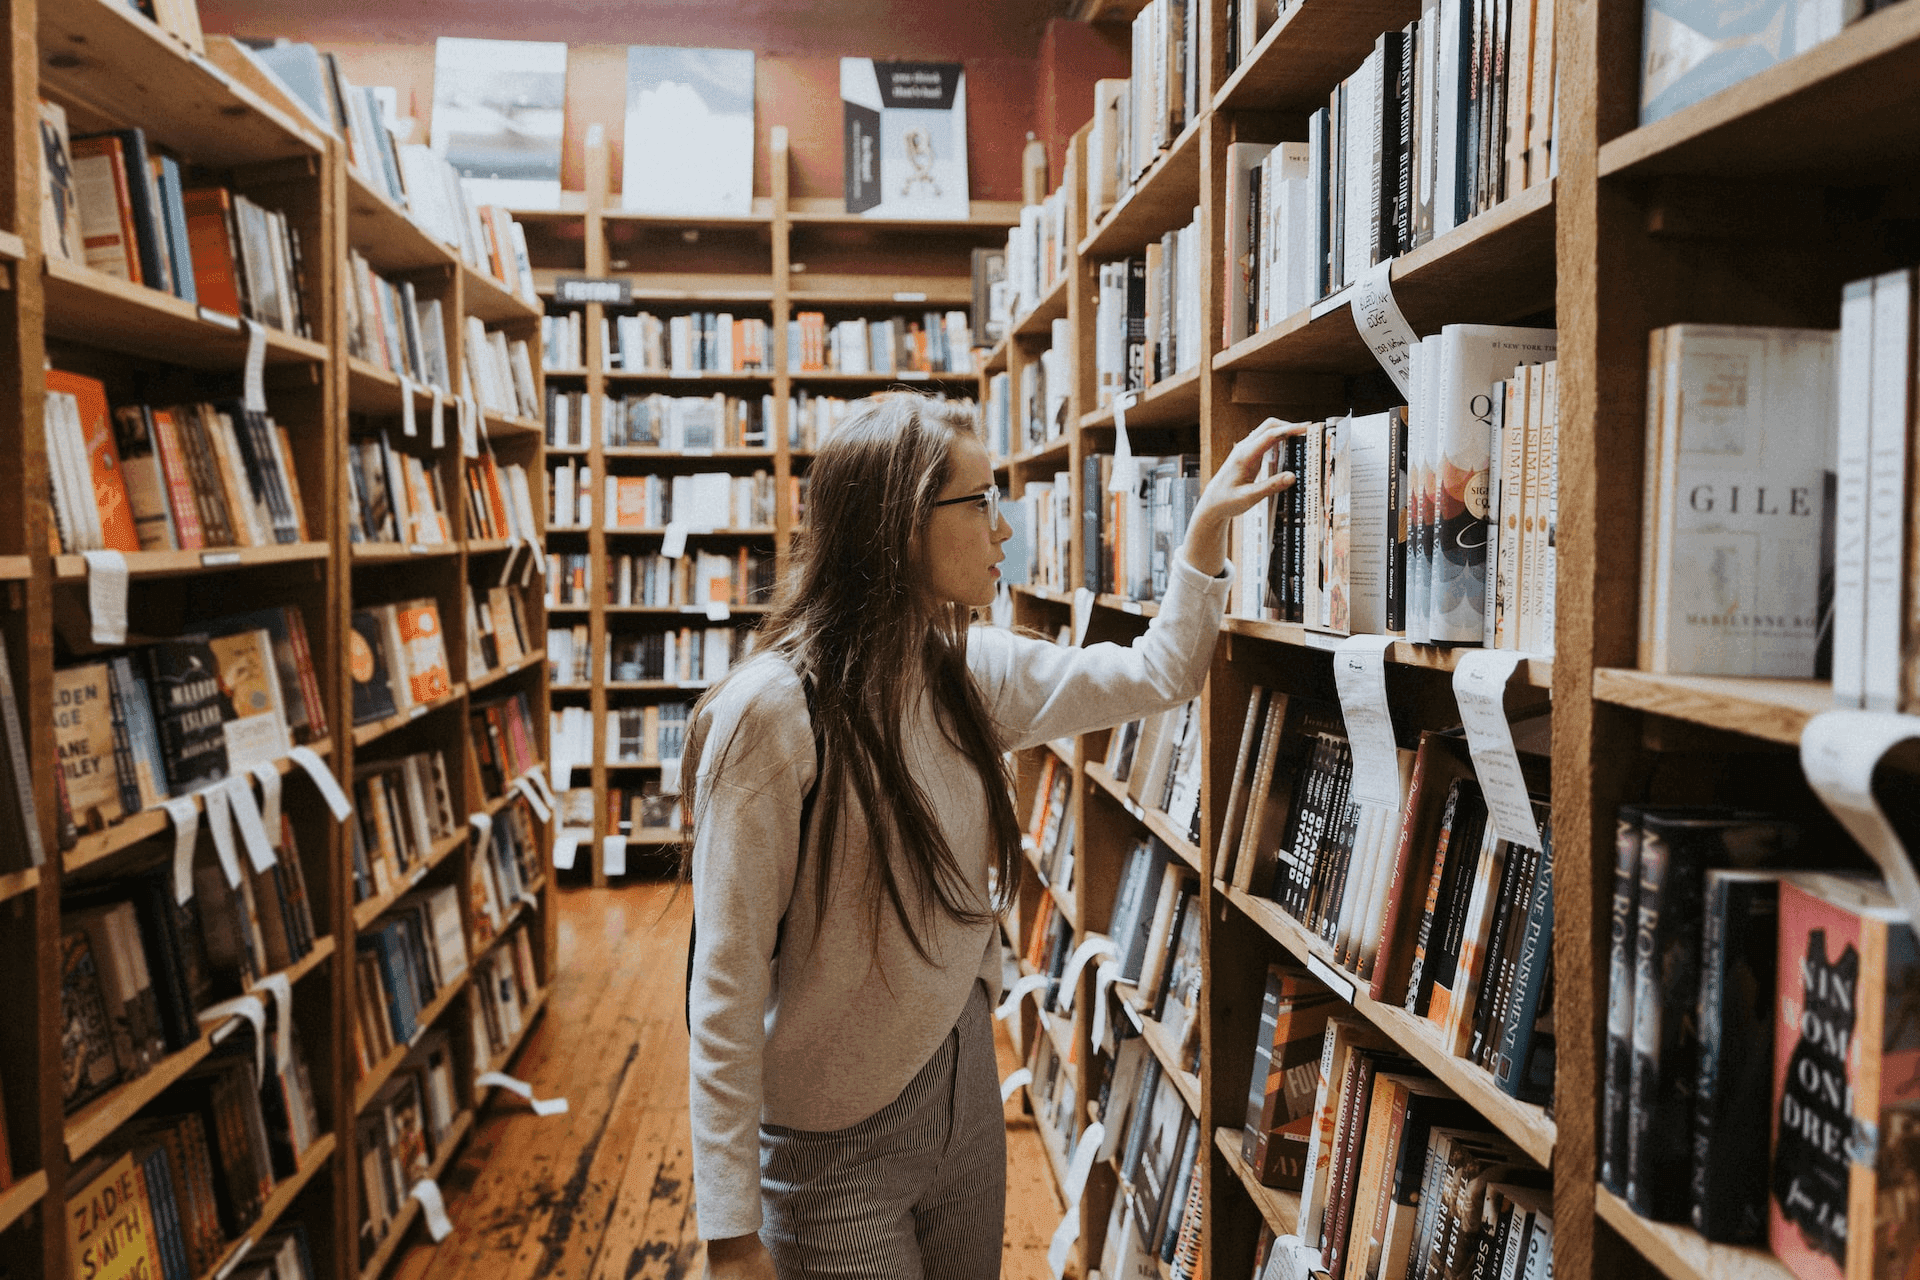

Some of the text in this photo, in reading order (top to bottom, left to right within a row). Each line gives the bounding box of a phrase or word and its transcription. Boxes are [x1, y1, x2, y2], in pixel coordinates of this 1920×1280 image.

[1397, 34, 1411, 244] THOMAS PYNCHON BLEEDING EDGE
[1371, 162, 1381, 218] BLEEDING
[1370, 221, 1379, 250] EDGE
[1366, 310, 1387, 329] EDGE
[1509, 427, 1521, 496] ISHMAEL
[1525, 428, 1538, 499] ISHMAEL
[1539, 426, 1552, 498] ISHMAEL
[1475, 498, 1488, 507] CO
[1505, 537, 1515, 611] DANIEL QUINN
[1522, 540, 1532, 616] DANIEL QUINN
[1535, 539, 1545, 617] DANIEL QUINN
[1406, 780, 1419, 816] Devil
[1296, 812, 1315, 885] OTARED
[1303, 815, 1323, 890] OTARED
[1391, 830, 1408, 889] Jerusalem
[1503, 862, 1515, 897] RAKHA
[1521, 853, 1529, 873] WHY
[1528, 856, 1537, 878] WHY
[1514, 883, 1523, 907] CAME
[1522, 887, 1531, 911] CAME
[1375, 899, 1394, 968] NAOMI RAGEN
[1451, 922, 1460, 956] Childhood
[1483, 935, 1500, 1000] CROCODILES
[1505, 920, 1541, 1049] PUNISHMENT
[1799, 955, 1853, 1013] NIN
[1347, 1079, 1364, 1152] UNRESTORED
[1340, 1157, 1351, 1199] WOMAN
[1382, 1161, 1391, 1188] RASH
[74, 1171, 134, 1243] ZADIE
[1375, 1190, 1387, 1231] READER
[1432, 1164, 1455, 1254] THE RISEN
[1446, 1177, 1468, 1268] THE RISEN
[1491, 1222, 1505, 1277] RON RASH
[1503, 1213, 1522, 1278] THE WORLD
